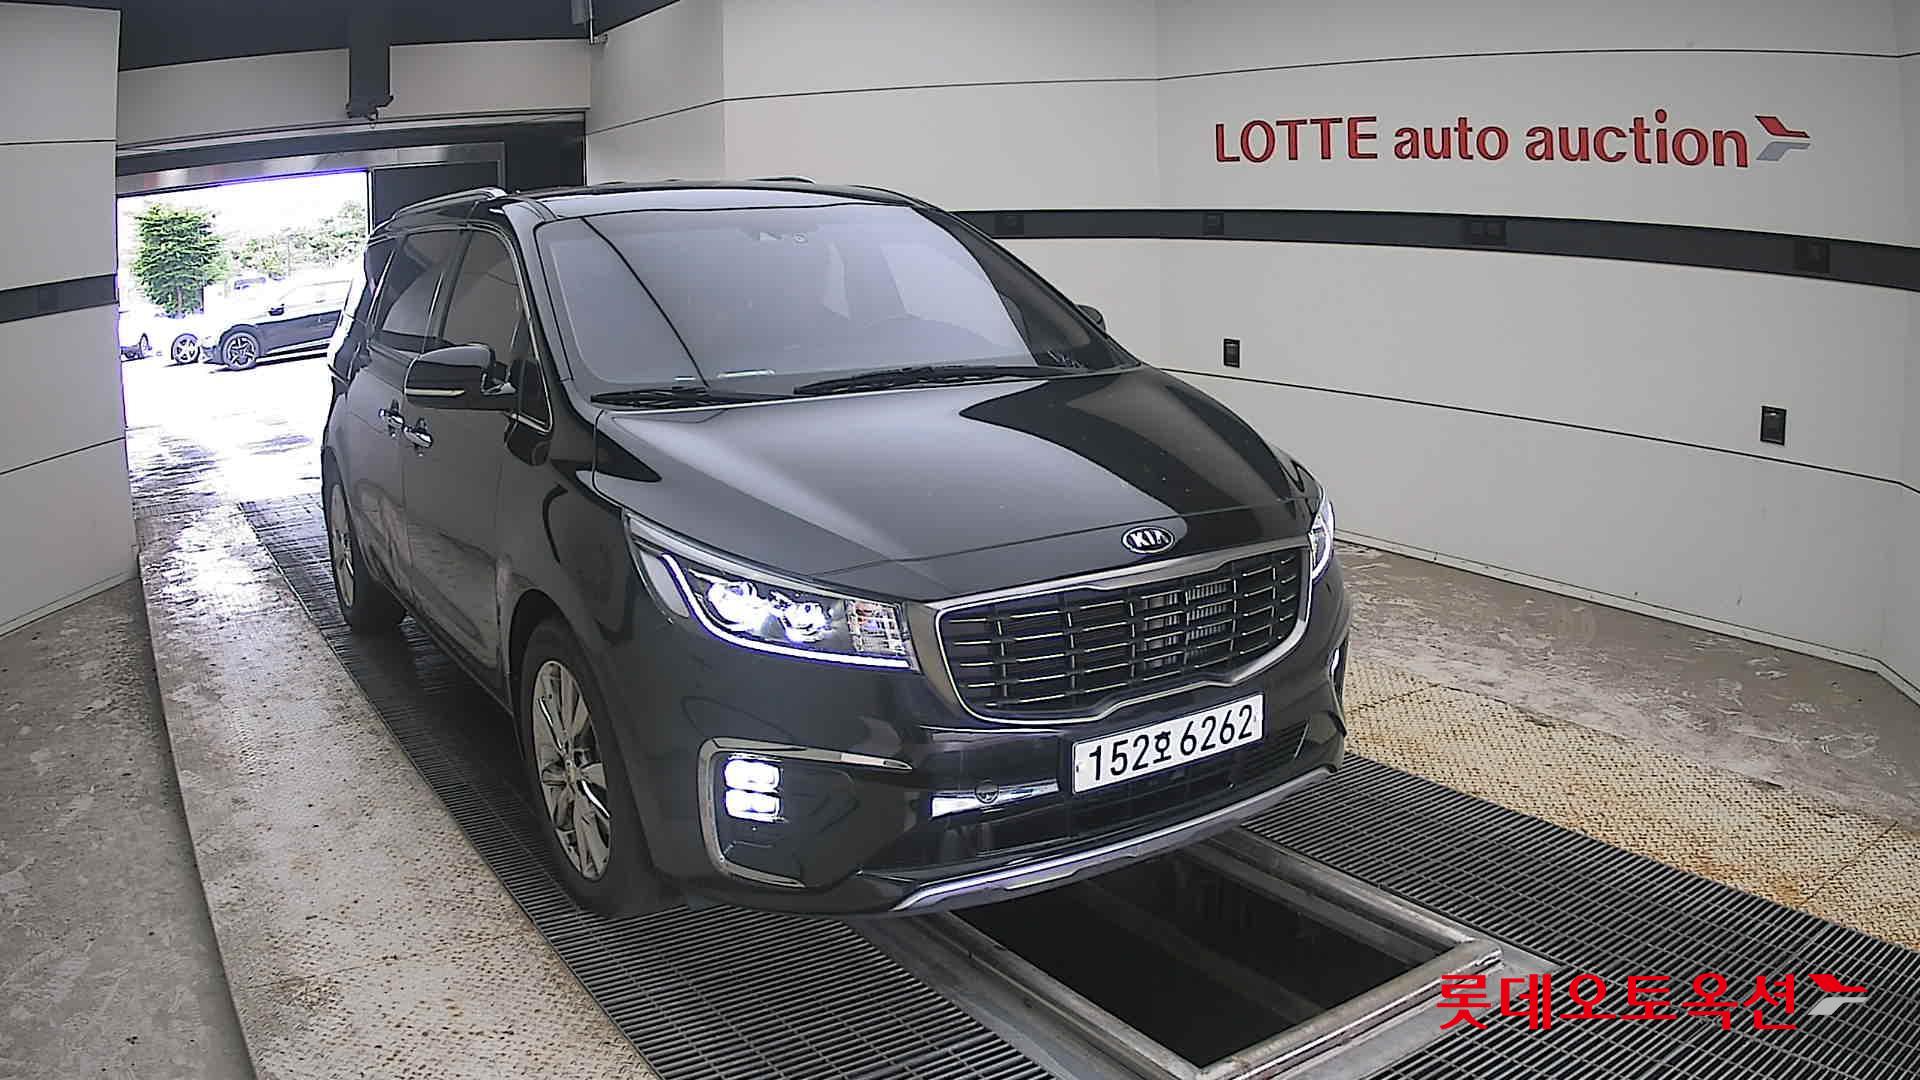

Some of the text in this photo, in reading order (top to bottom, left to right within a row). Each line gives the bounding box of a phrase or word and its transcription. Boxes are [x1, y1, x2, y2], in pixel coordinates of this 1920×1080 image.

[1215, 109, 1751, 168] LOTTE auto auction
[1129, 529, 1170, 548] KIA
